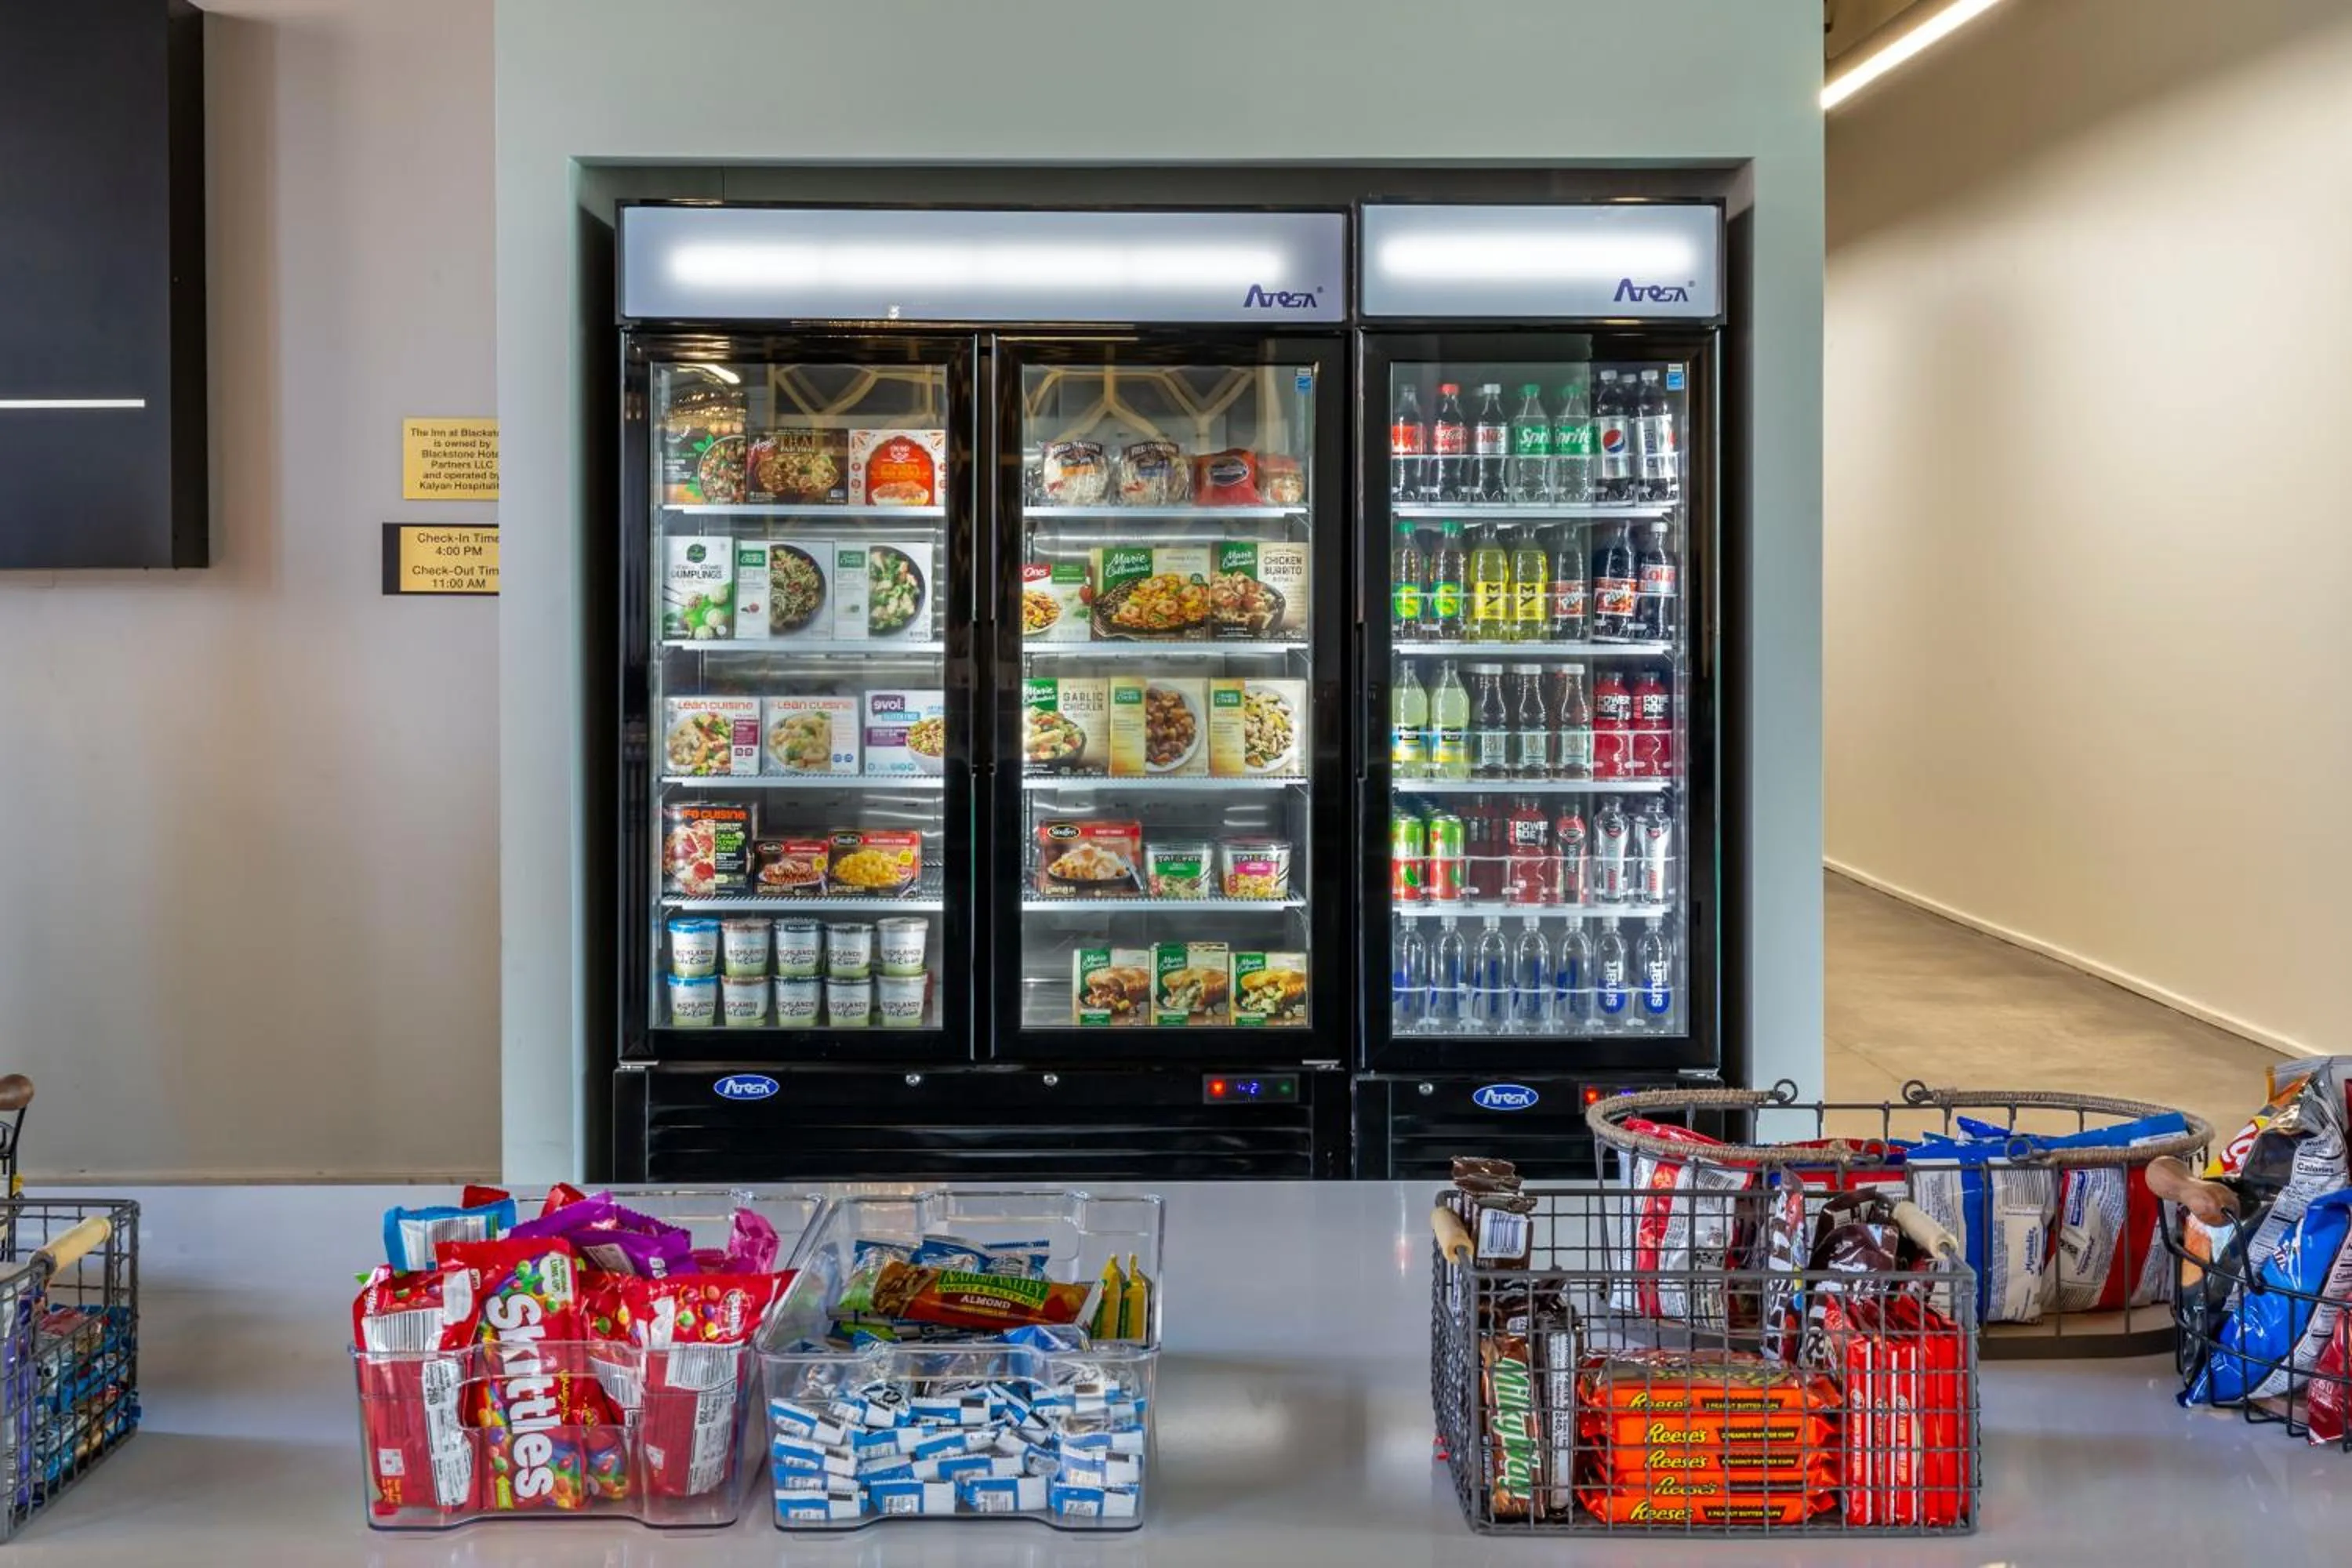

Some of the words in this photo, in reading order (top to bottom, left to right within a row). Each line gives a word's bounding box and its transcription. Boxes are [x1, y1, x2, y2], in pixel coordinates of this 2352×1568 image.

[411, 428, 427, 437] The
[430, 428, 447, 437] Inn
[434, 439, 441, 448] is
[445, 439, 477, 448] owned
[479, 439, 491, 450] by
[421, 449, 474, 459] Blackstone
[431, 460, 471, 469] Partners
[474, 460, 494, 469] LLC
[423, 471, 441, 480] and
[444, 471, 487, 481] operated
[419, 481, 452, 492] Kalyan
[416, 532, 470, 543] Check-In
[435, 546, 460, 556] 4:00
[463, 546, 483, 556] PM
[1263, 556, 1303, 565] CHICKEN
[412, 565, 474, 576] Check-Out
[1264, 567, 1302, 575] BURRITO
[431, 579, 463, 588] 11:00
[466, 579, 486, 588] AM
[1062, 691, 1104, 702] GARLIC
[1062, 702, 1104, 712] CHICKEN
[1606, 960, 1617, 1007] smart
[1651, 960, 1664, 1007] smart
[942, 1269, 995, 1285] NATURE
[996, 1274, 1044, 1299] VALLEY
[960, 1294, 1011, 1309] ALMOND
[486, 1292, 563, 1499] Skittles
[1645, 1423, 1707, 1443] Reese's
[1645, 1450, 1707, 1468] Reese's
